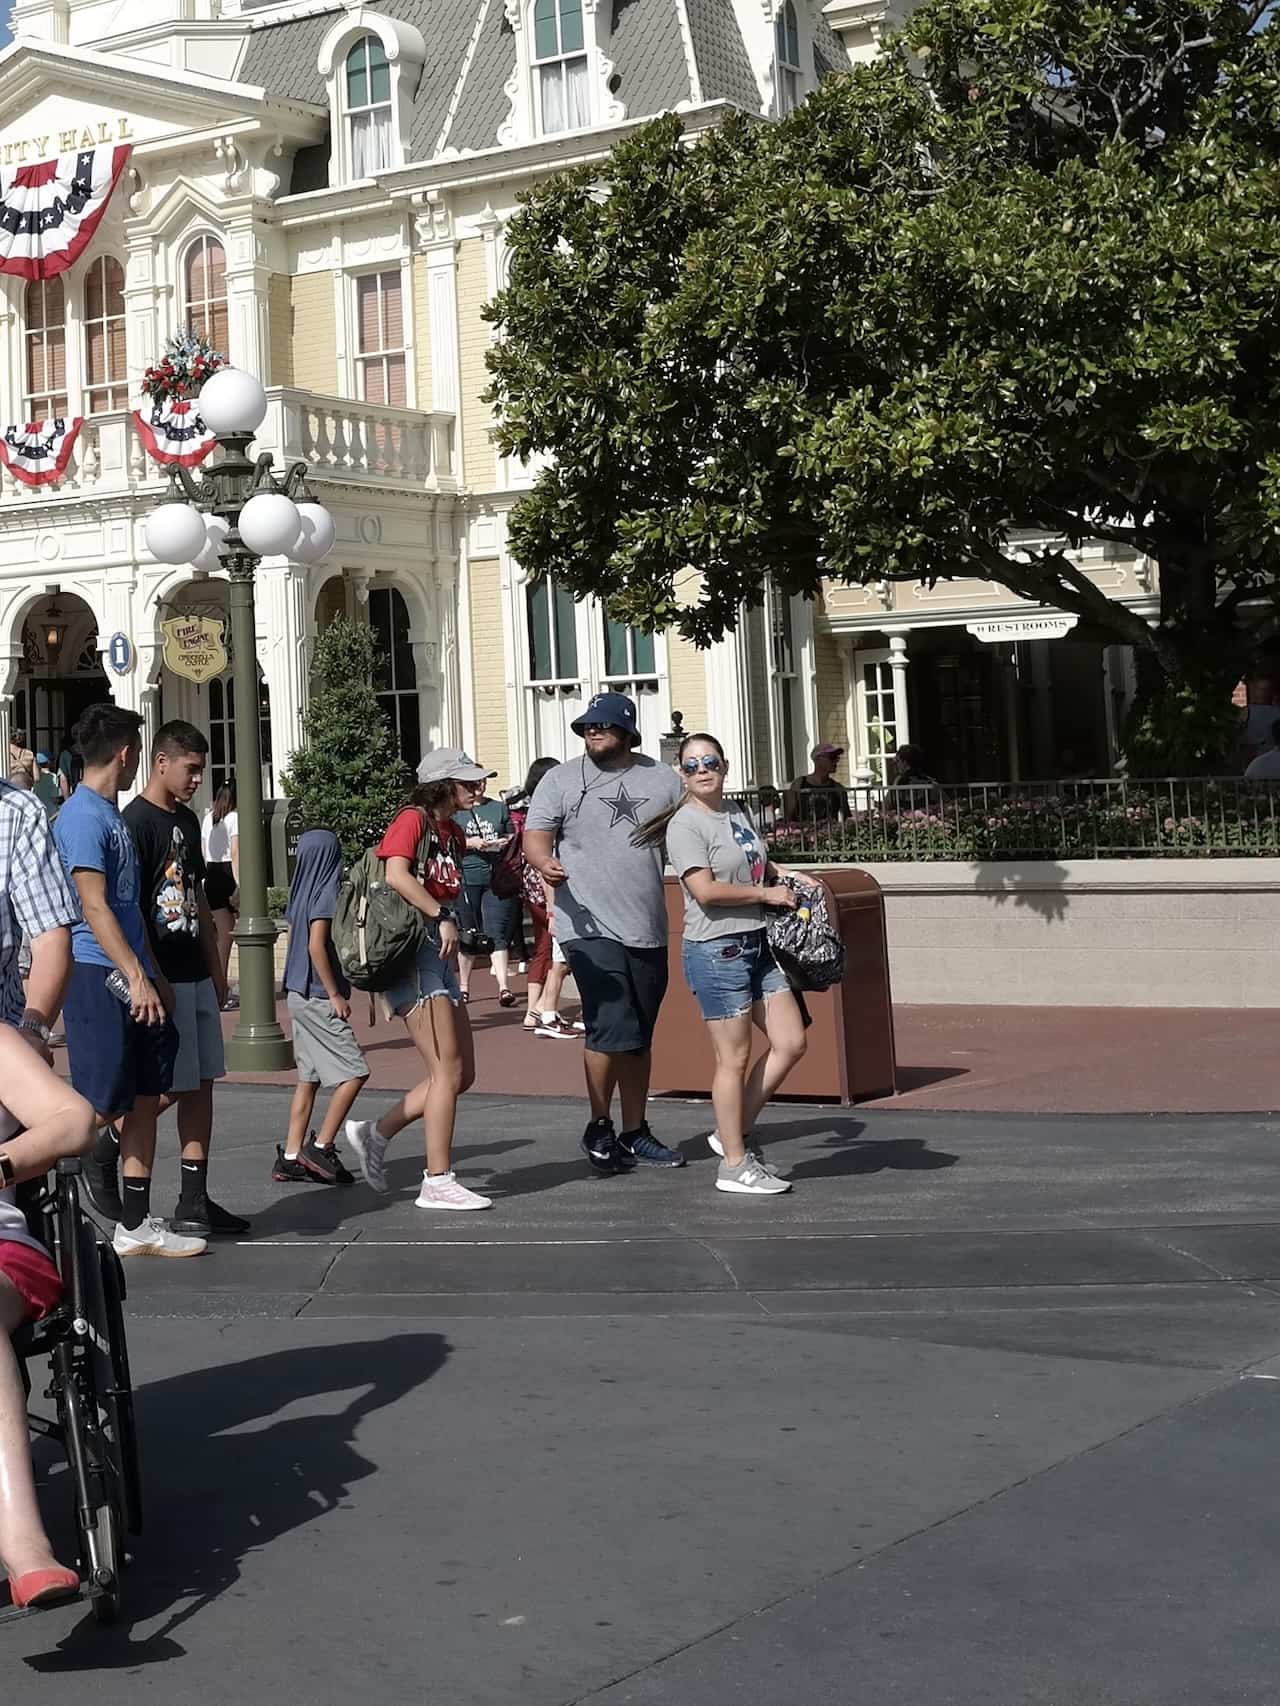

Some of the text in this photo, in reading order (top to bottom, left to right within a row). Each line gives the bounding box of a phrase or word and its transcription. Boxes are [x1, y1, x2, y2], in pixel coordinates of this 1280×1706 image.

[58, 117, 134, 154] HALL
[176, 624, 197, 637] FIRE
[988, 621, 1068, 633] RESTROOMS
[183, 632, 210, 648] ENGINE
